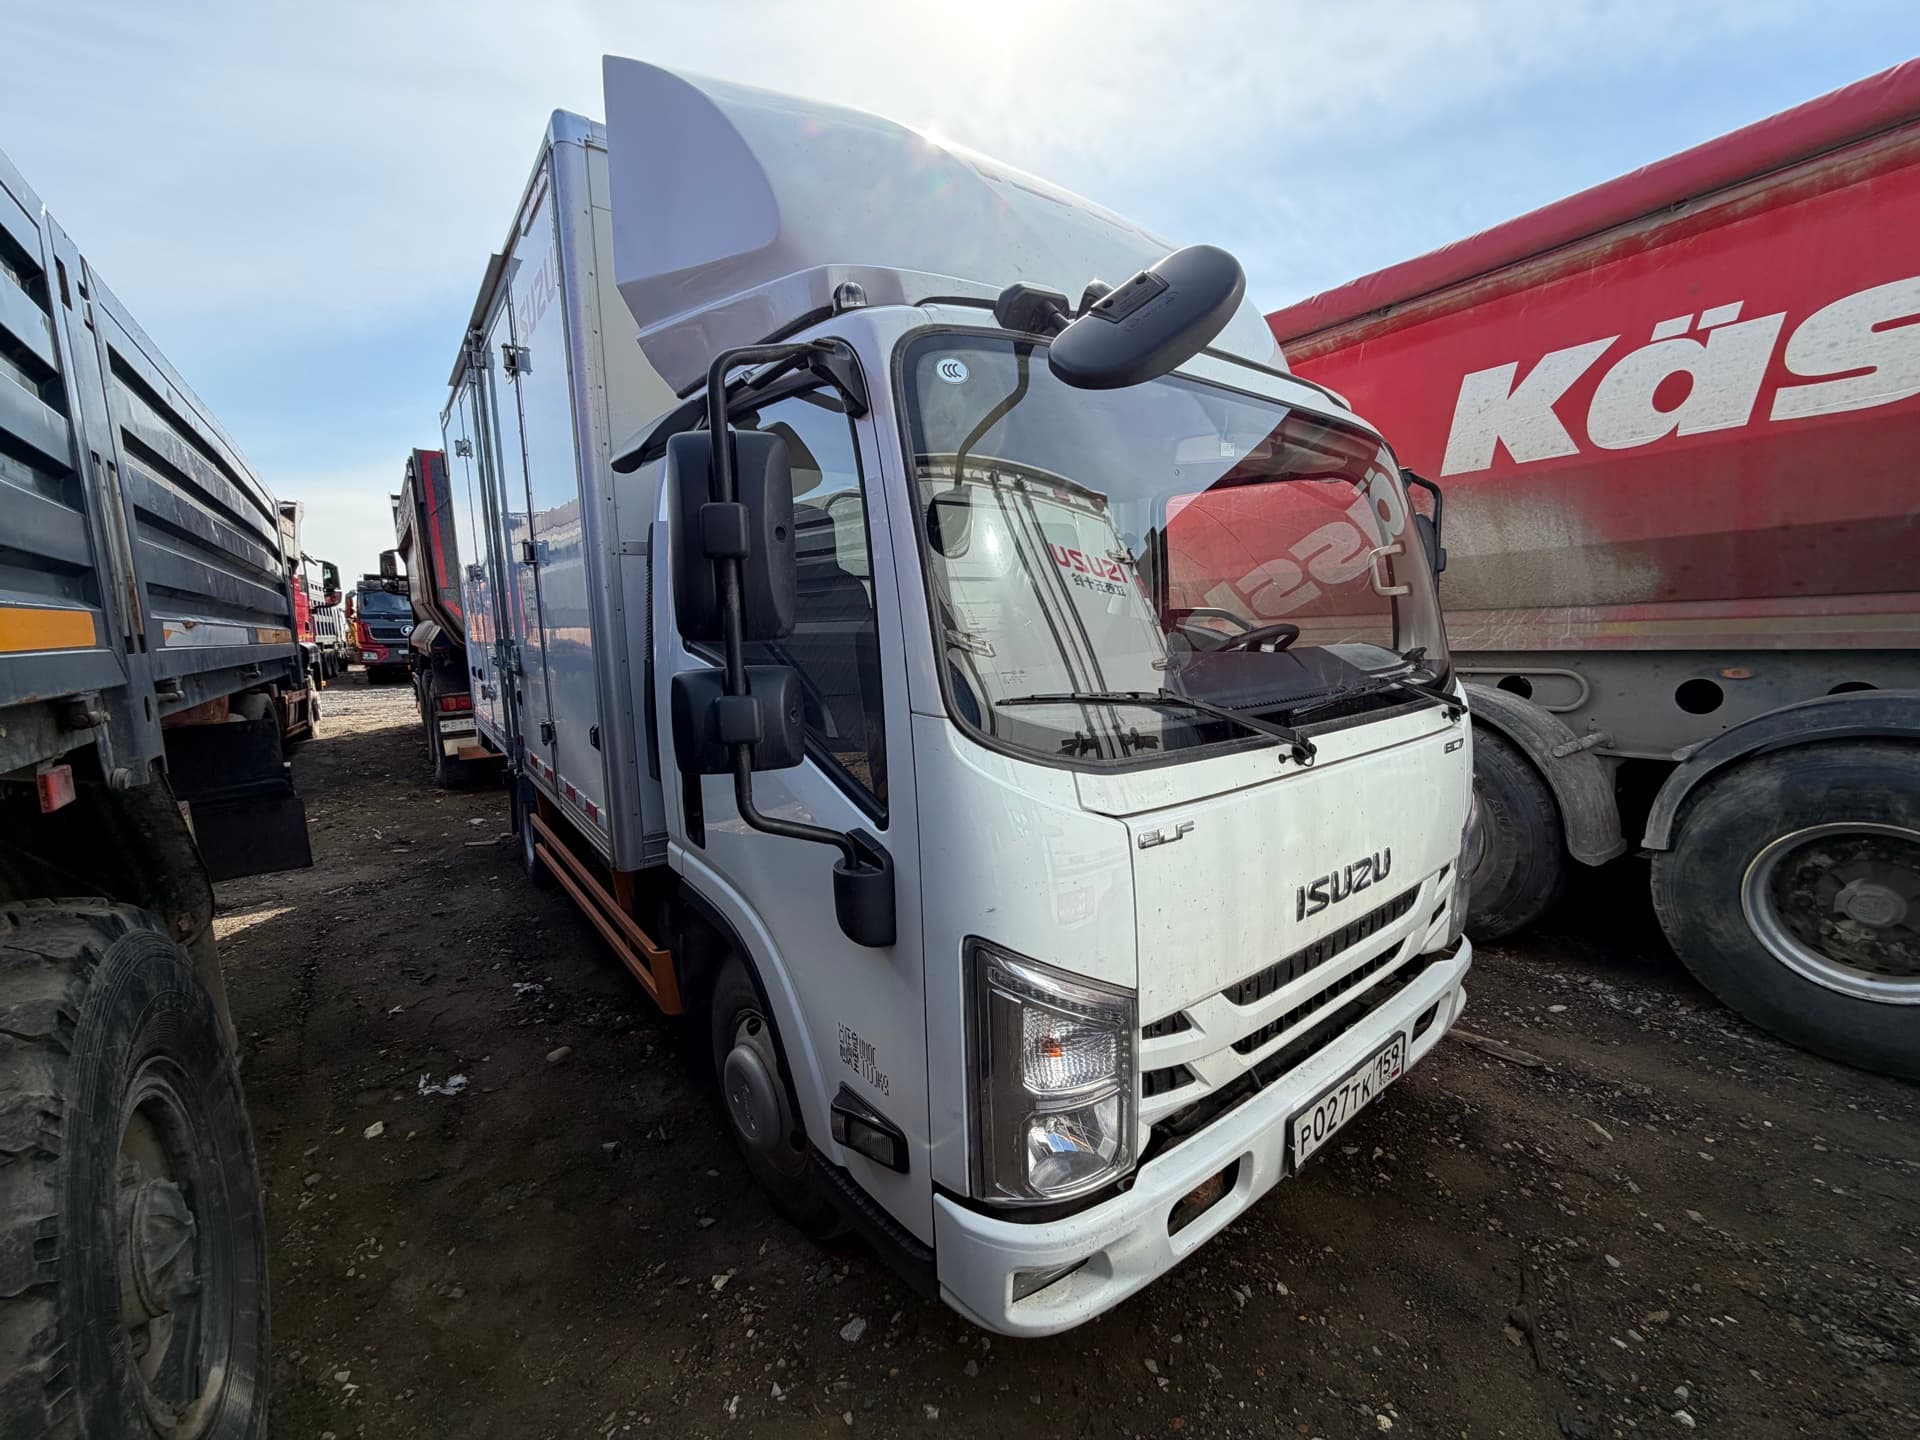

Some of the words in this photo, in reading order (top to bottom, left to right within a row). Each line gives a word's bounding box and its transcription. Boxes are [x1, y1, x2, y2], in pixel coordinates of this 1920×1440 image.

[1137, 819, 1195, 850] ELF
[1296, 846, 1391, 922] ISUZU
[1375, 1043, 1400, 1078] 159
